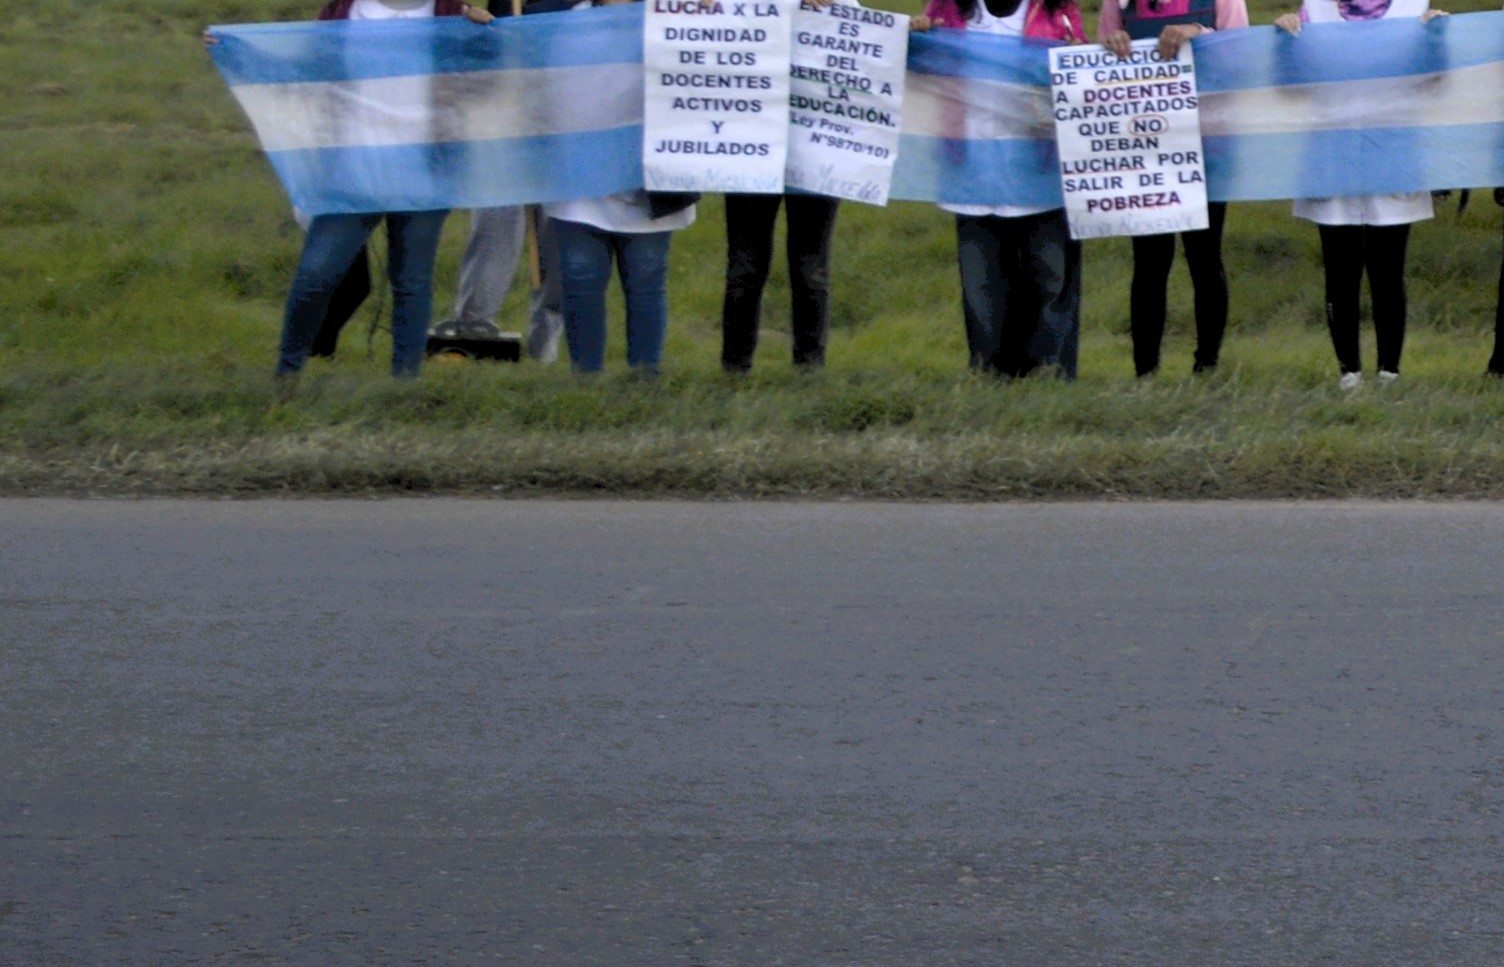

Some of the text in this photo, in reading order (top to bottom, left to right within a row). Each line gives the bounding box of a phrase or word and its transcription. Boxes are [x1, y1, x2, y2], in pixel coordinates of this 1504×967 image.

[733, 3, 746, 17] X
[755, 4, 779, 18] LA
[829, 2, 895, 28] ESTADO
[665, 26, 767, 42] DIGNIDAD
[838, 21, 860, 38] ES
[798, 31, 884, 59] GARANTE
[679, 50, 757, 66] DE LOS
[826, 54, 859, 72] DEL
[661, 73, 772, 89] DOCENTES
[1053, 72, 1077, 86] DE
[828, 85, 850, 102] LA
[881, 82, 893, 97] A
[1056, 81, 1191, 104] A DOCENTES
[672, 97, 763, 113] ACTIVOS
[1055, 96, 1198, 121] CAPACITADOS
[712, 120, 725, 135] Y
[1079, 119, 1163, 137] QUE NO
[655, 140, 770, 157] JUBILADOS
[1091, 137, 1159, 153] DEBAN
[1062, 151, 1199, 174] LUCHAR POR
[1065, 169, 1203, 193] SALIR DE LA
[1086, 191, 1182, 214] POBREZA
